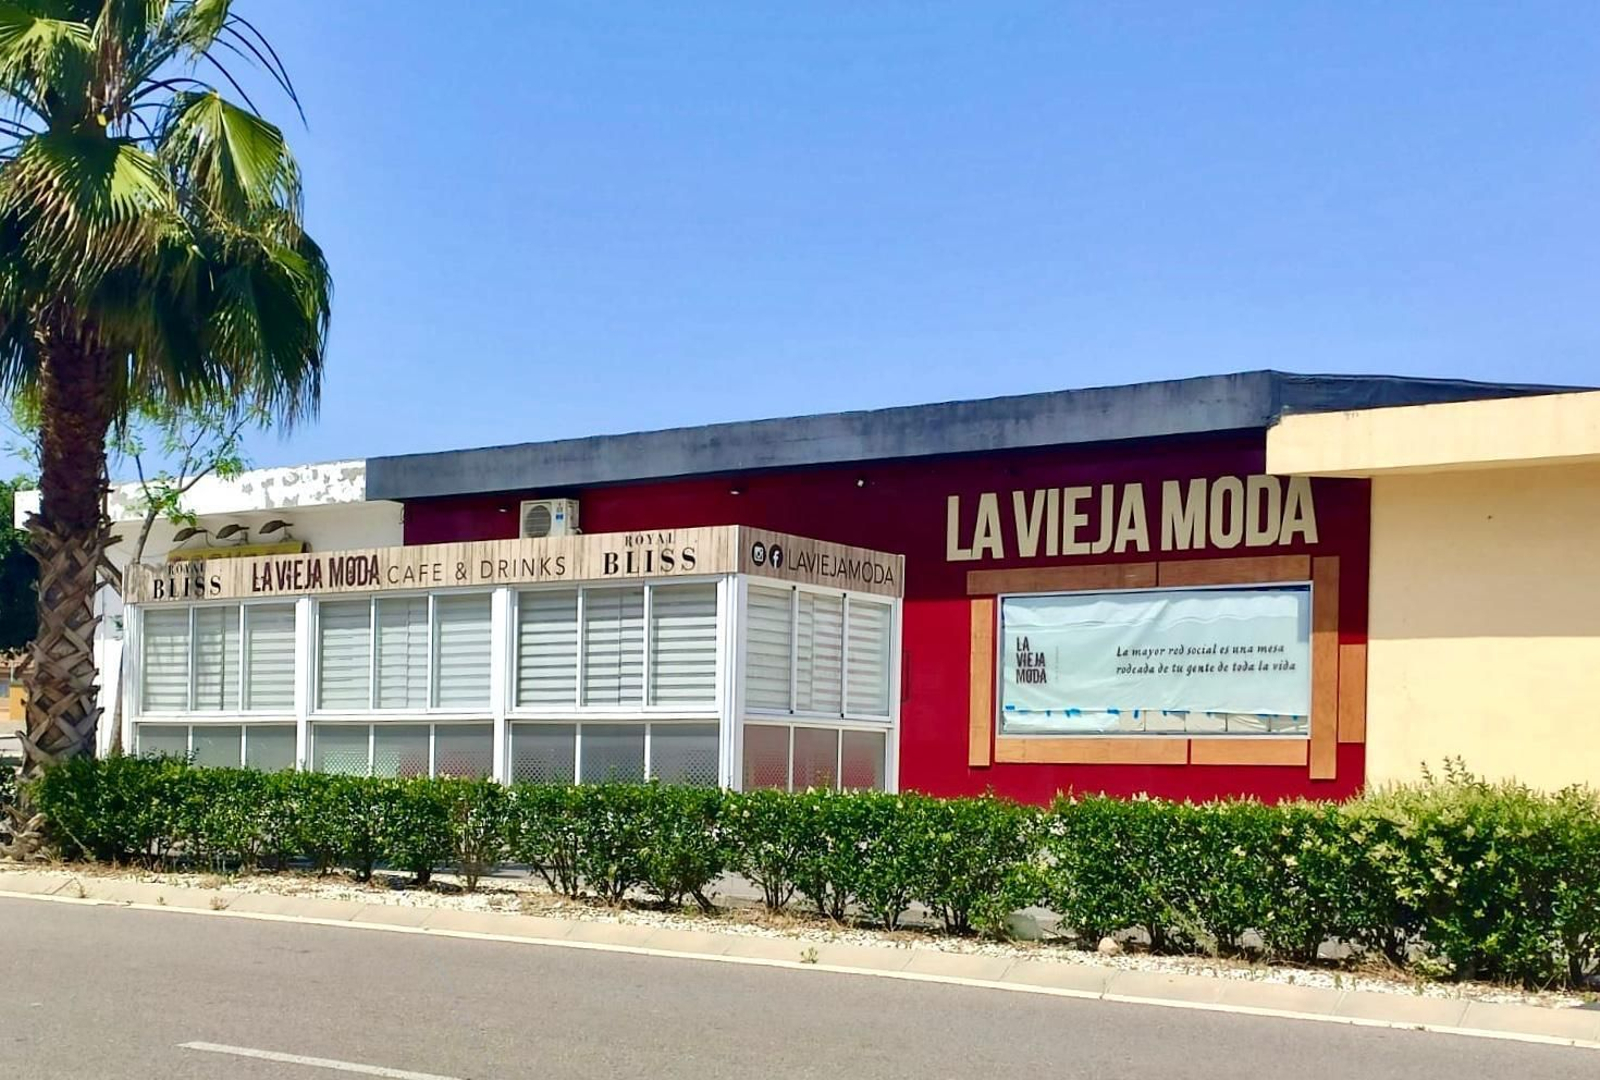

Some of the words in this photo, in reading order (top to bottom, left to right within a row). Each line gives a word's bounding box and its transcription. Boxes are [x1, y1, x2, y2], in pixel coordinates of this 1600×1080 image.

[946, 493, 1005, 562] LA
[1012, 483, 1150, 557] VIEJA
[1161, 474, 1319, 551] MODA
[625, 532, 676, 547] ROYAL
[603, 547, 696, 575] BLISS
[788, 548, 895, 586] LAVIEJAMODA
[252, 562, 273, 592] LA
[275, 558, 323, 590] VIEJA
[328, 554, 381, 588] MODA
[387, 563, 442, 584] CAFE
[455, 561, 467, 581] &
[480, 555, 567, 579] DRINKS
[153, 575, 222, 599] BLISS
[1016, 636, 1030, 652] LA
[1116, 646, 1128, 657] La
[1131, 648, 1166, 659] mayor
[1168, 644, 1184, 655] red
[1186, 643, 1217, 655] social
[1219, 646, 1229, 655] es
[1232, 645, 1254, 654] una
[1257, 644, 1285, 653] mesa
[1016, 652, 1046, 668] VIEJA
[1116, 662, 1155, 674] rodeada
[1157, 662, 1169, 674] de
[1172, 664, 1183, 673] tu
[1186, 663, 1215, 676] gente
[1217, 660, 1229, 672] de
[1232, 660, 1255, 672] toda
[1258, 660, 1269, 671] la
[1272, 659, 1296, 671] vida
[1016, 668, 1047, 684] MODA
